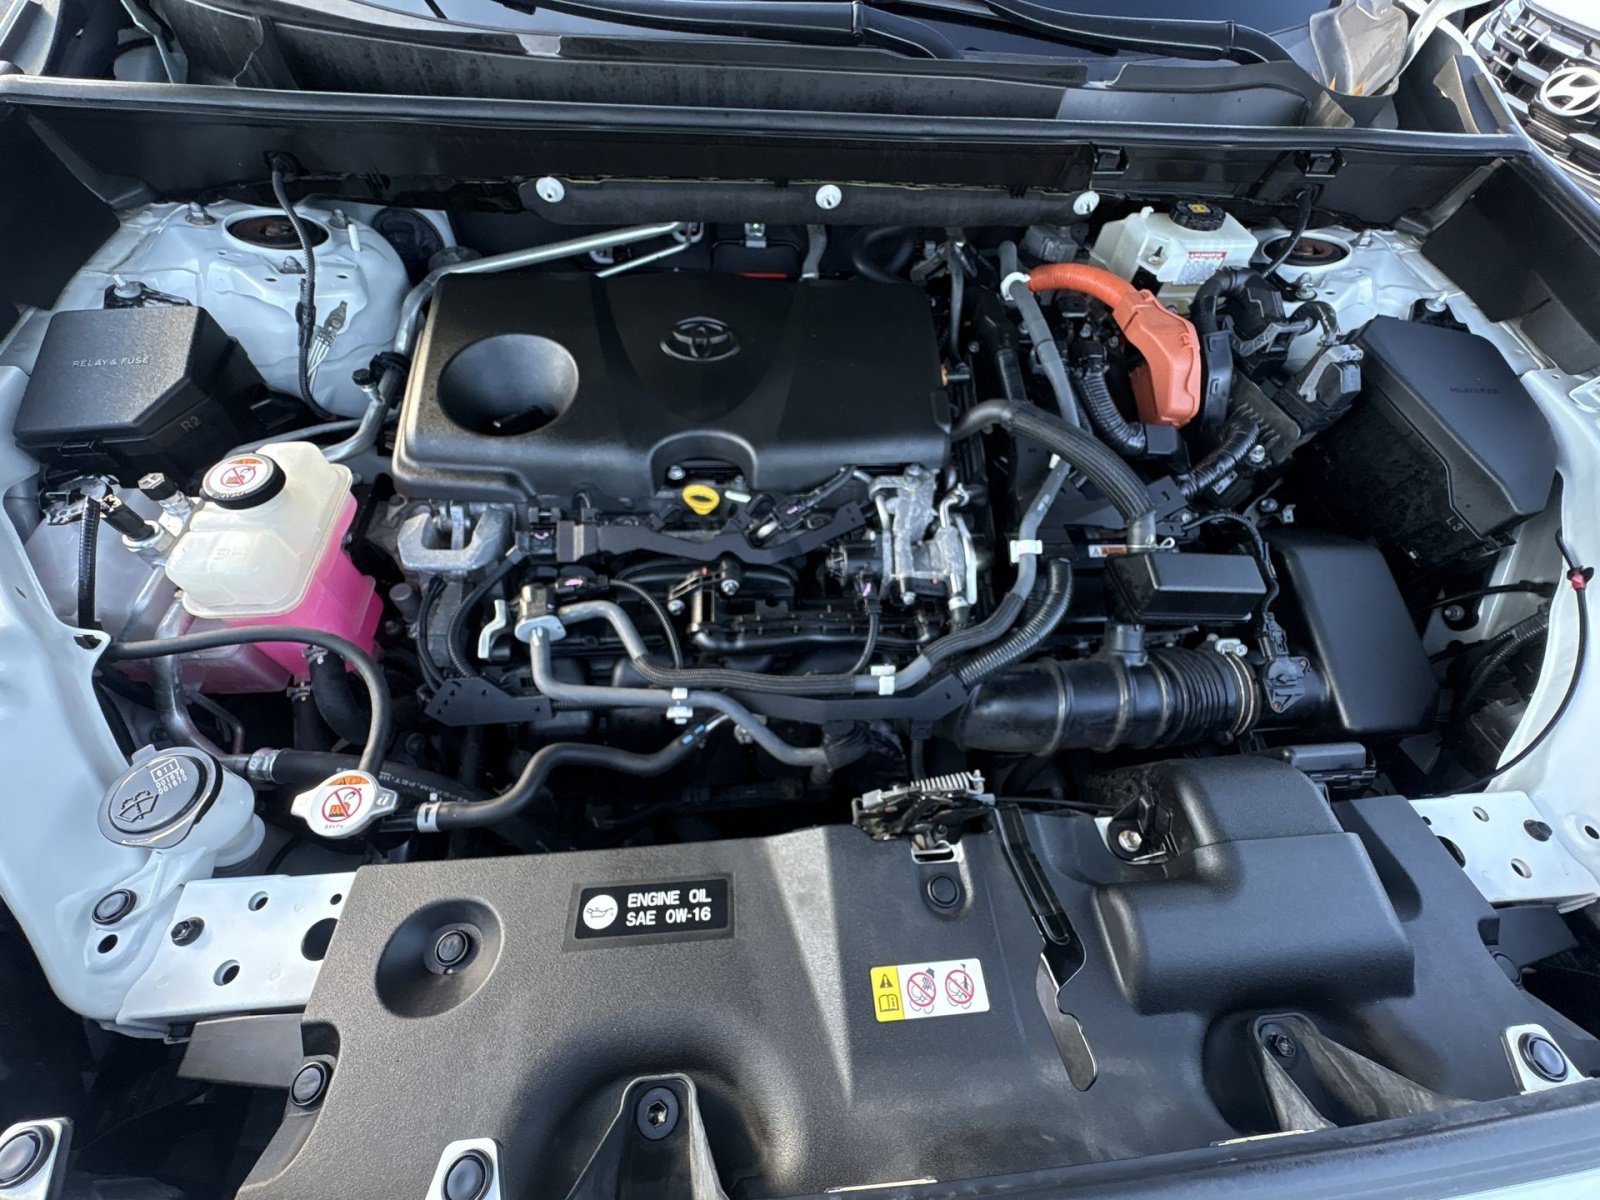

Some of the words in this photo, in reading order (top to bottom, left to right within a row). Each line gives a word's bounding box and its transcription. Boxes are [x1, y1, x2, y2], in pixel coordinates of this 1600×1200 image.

[120, 355, 151, 365] FUSE
[180, 415, 201, 432] R2
[1446, 515, 1464, 532] L3
[627, 890, 680, 908] ENGINE
[689, 888, 712, 904] OIL
[625, 910, 657, 927] SAE
[665, 906, 712, 924] 0W-16
